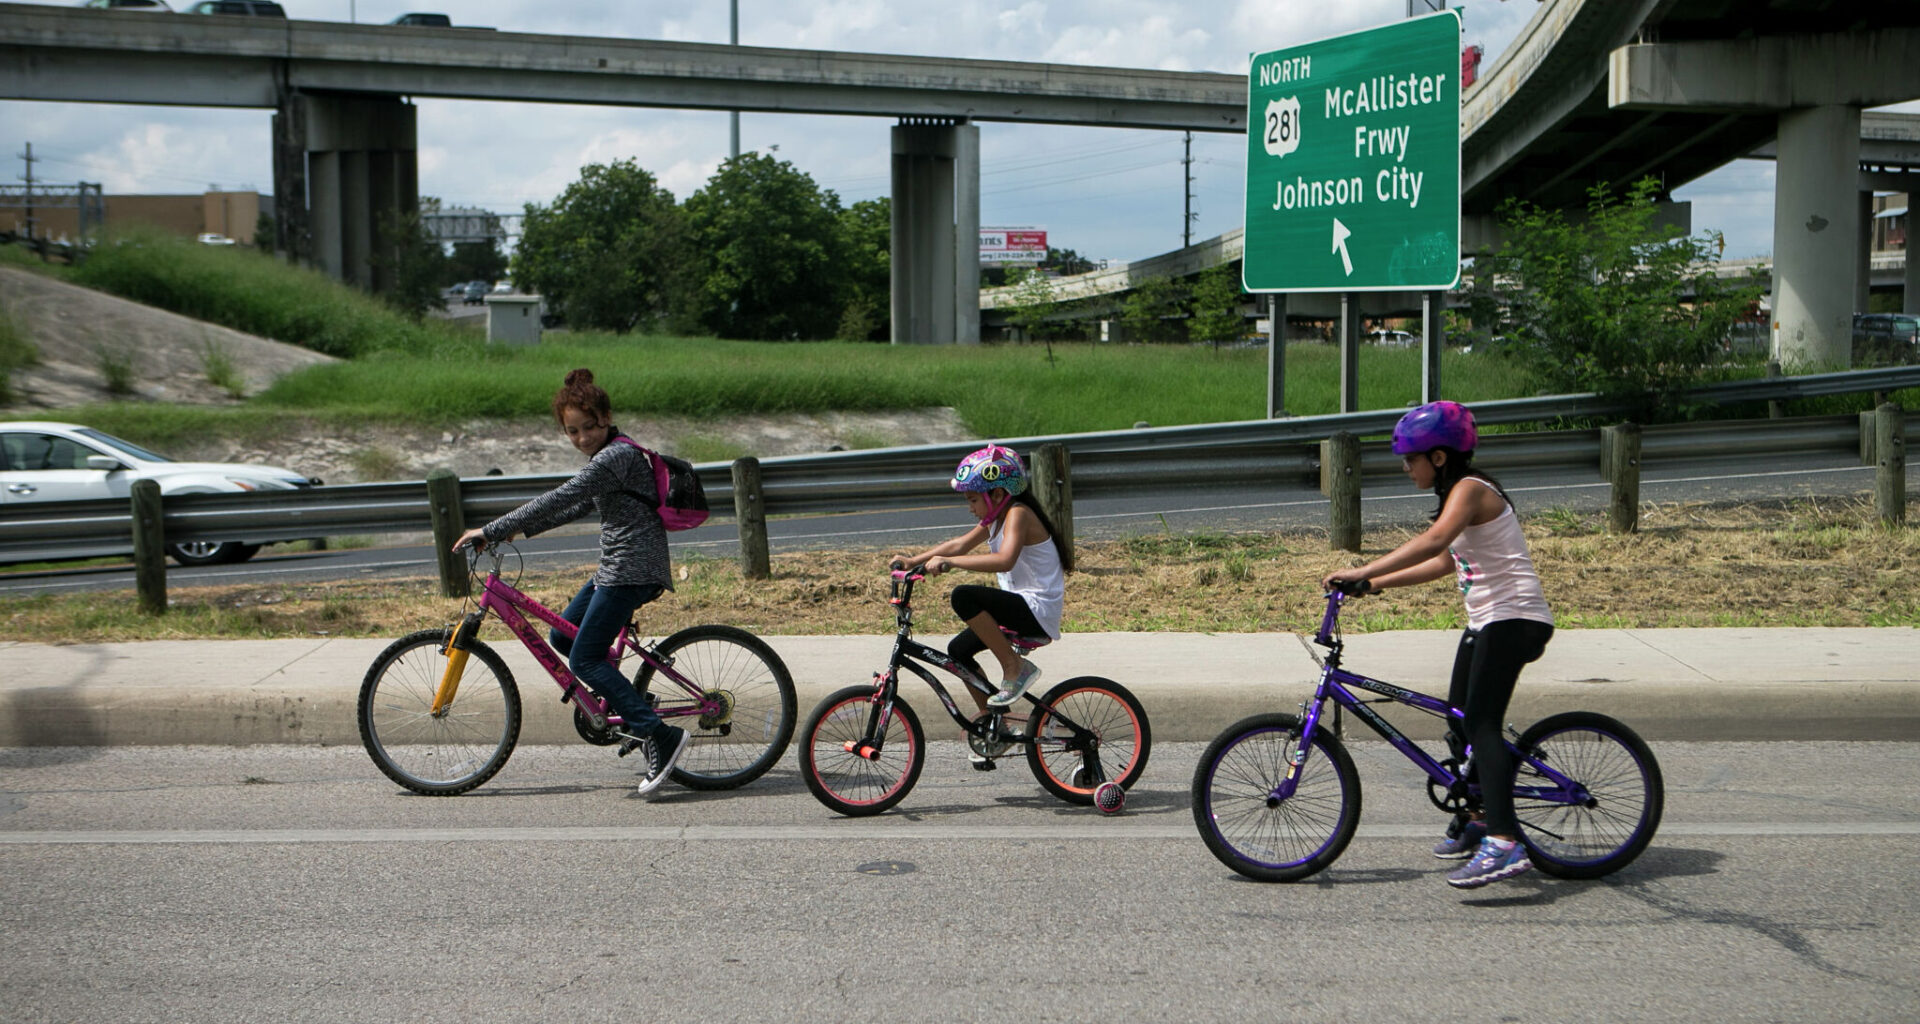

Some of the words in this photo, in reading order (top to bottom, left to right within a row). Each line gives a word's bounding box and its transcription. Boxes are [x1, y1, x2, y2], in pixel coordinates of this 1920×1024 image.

[1260, 55, 1311, 87] NORTH
[1325, 73, 1446, 119] McAllister
[1268, 108, 1297, 144] 281
[1355, 125, 1410, 162] Frwy
[1273, 175, 1363, 210] Johnson
[1376, 166, 1423, 208] City
